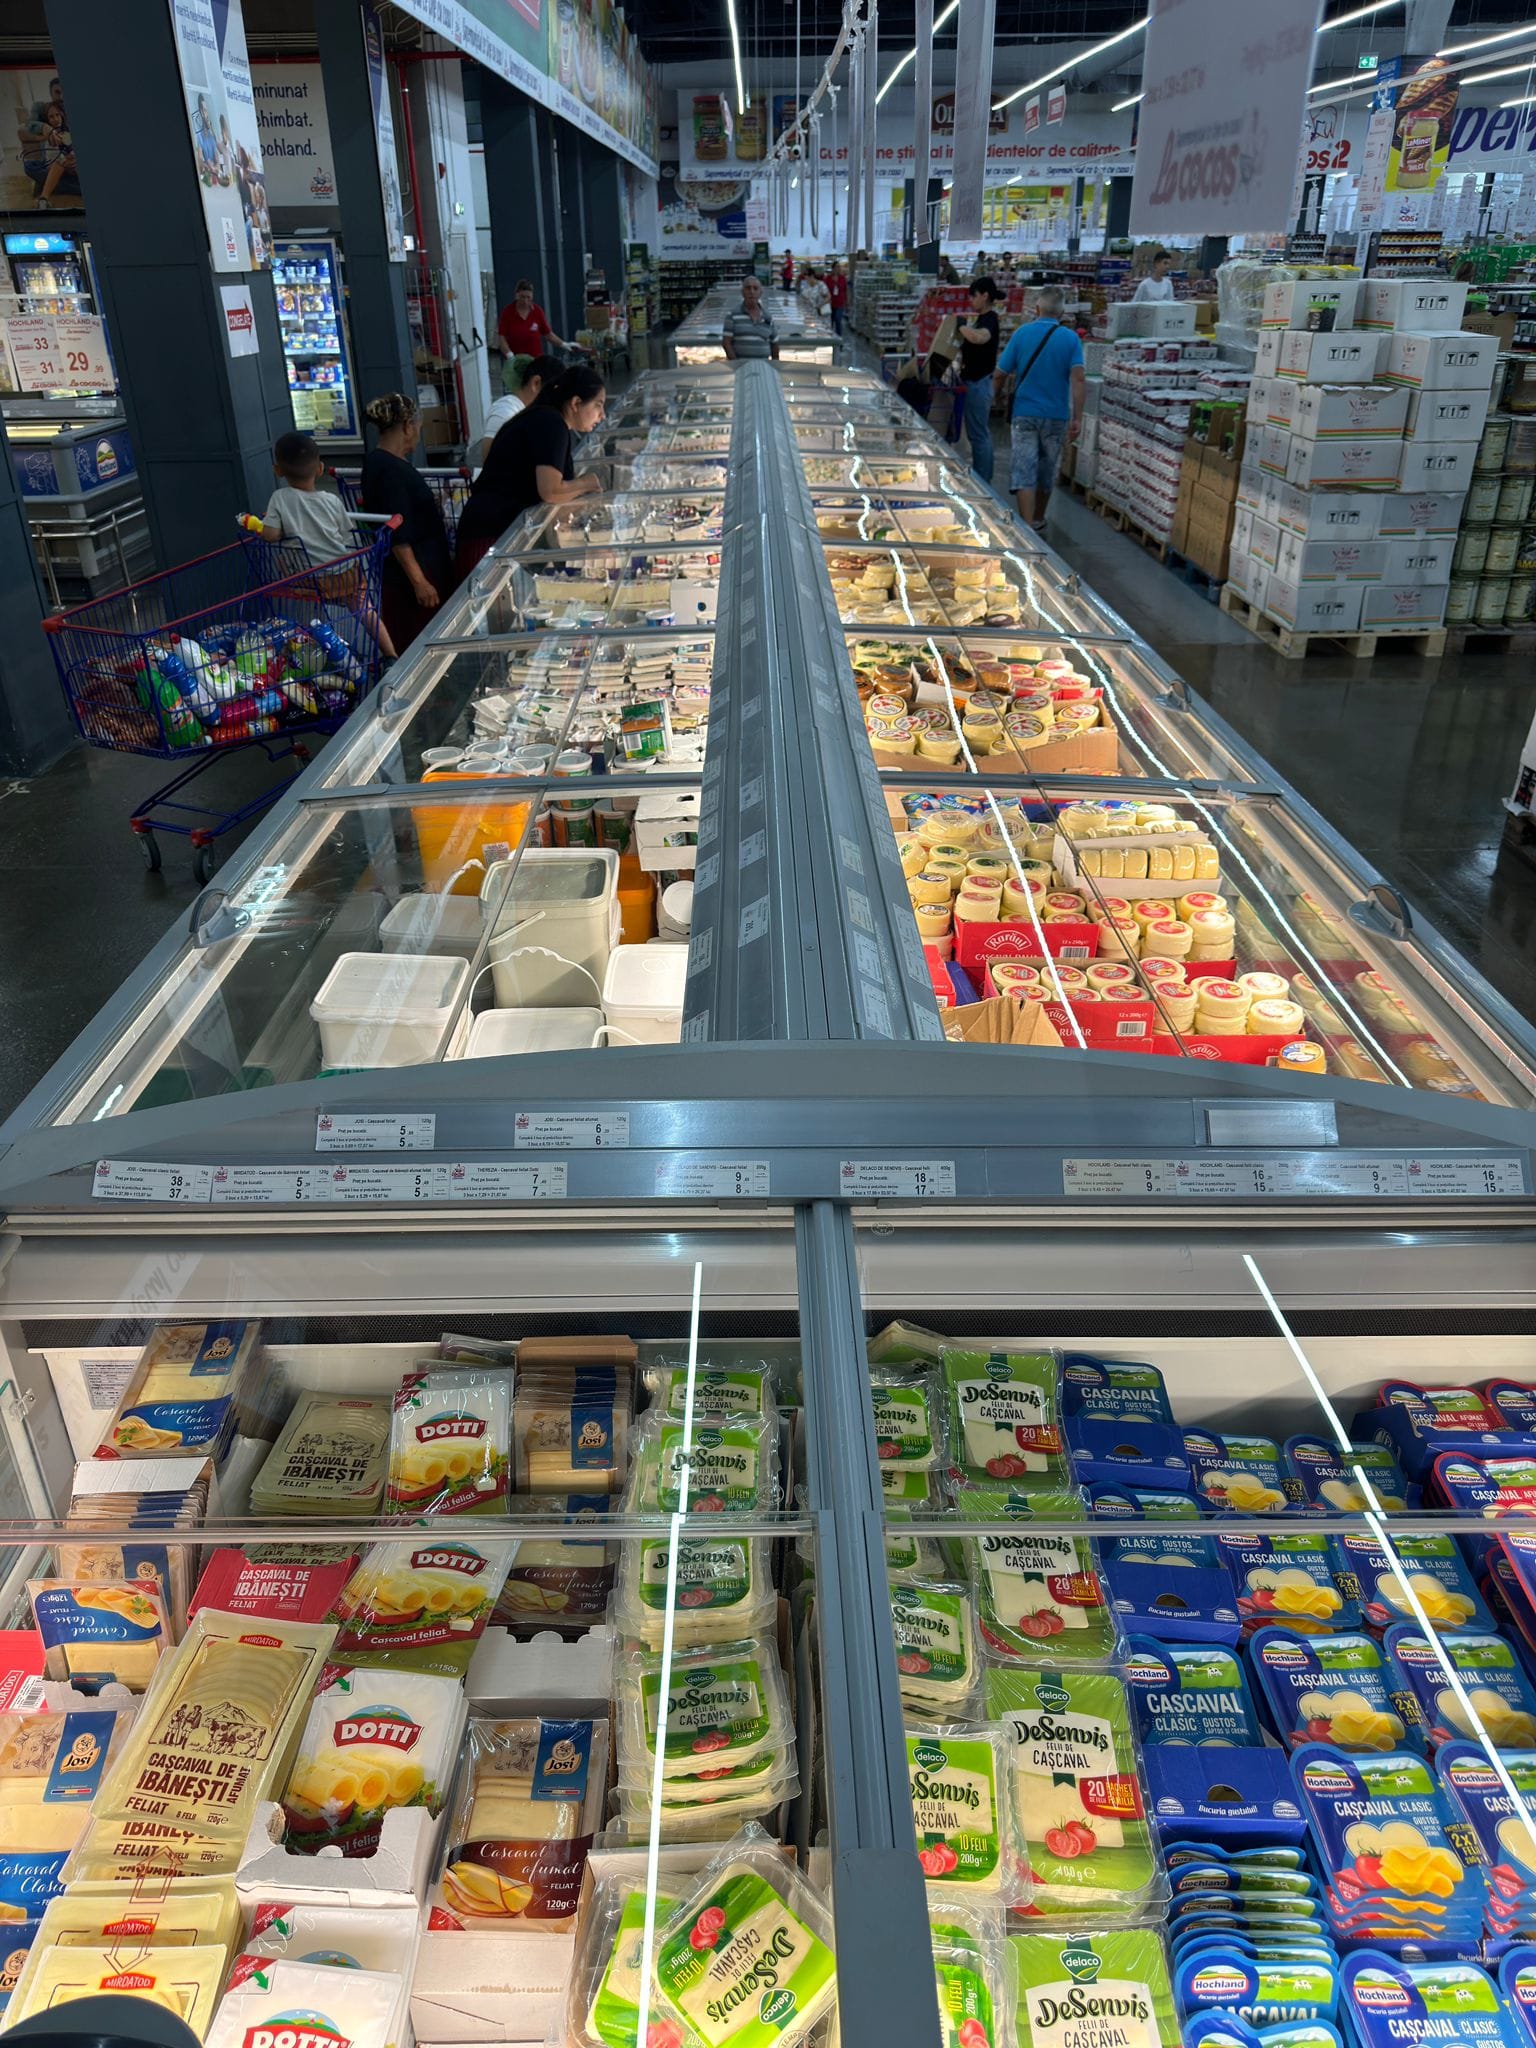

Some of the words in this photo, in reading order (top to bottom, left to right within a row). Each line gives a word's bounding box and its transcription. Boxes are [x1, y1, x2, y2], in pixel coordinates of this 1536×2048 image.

[1048, 144, 1066, 158] de
[1070, 145, 1121, 158] calitate
[1331, 139, 1351, 169] 2
[34, 337, 49, 350] 33
[67, 352, 89, 371] 29
[40, 361, 54, 374] 31
[399, 1126, 406, 1135] 5
[595, 1124, 602, 1133] 6
[399, 1138, 405, 1147] 5
[595, 1136, 601, 1145] 6
[415, 1175, 421, 1185] 5
[532, 1174, 539, 1184] 7
[735, 1172, 742, 1181] 9
[915, 1173, 926, 1183] 18
[1145, 1170, 1152, 1180] 9
[1253, 1170, 1264, 1180] 16
[1372, 1171, 1379, 1181] 9
[1482, 1171, 1494, 1180] 16
[170, 1176, 183, 1186] 38
[296, 1177, 303, 1186] 5
[414, 1187, 420, 1197] 5
[532, 1187, 538, 1196] 7
[735, 1184, 742, 1194] 8
[915, 1185, 927, 1195] 17
[1146, 1182, 1153, 1192] 9
[1253, 1182, 1266, 1192] 15
[1373, 1184, 1380, 1193] 9
[1484, 1183, 1496, 1192] 15
[169, 1188, 181, 1198] 37
[295, 1190, 302, 1199] 5
[207, 1348, 228, 1358] Josi
[988, 1366, 1012, 1375] delaco
[1066, 1372, 1102, 1381] Hochland
[1086, 1400, 1120, 1409] CLASIC
[1124, 1401, 1152, 1409] GUSTOS
[980, 1406, 1026, 1421] CAȘCAVAL
[421, 1422, 479, 1438] DOTTI
[1022, 1427, 1036, 1439] 20
[580, 1435, 602, 1445] Josi
[1296, 1452, 1332, 1461] Hochland
[352, 1460, 369, 1468] DE
[1249, 1463, 1275, 1471] CLASIC
[282, 1463, 366, 1484] IBĂNEȘTI
[1448, 1475, 1485, 1483] Hochland
[278, 1480, 311, 1488] FELIAT
[451, 1491, 476, 1506] feliat
[1120, 1538, 1157, 1549] CLASIC
[1162, 1539, 1193, 1549] GUSTOS
[416, 1553, 480, 1571] DOTTI
[1004, 1554, 1056, 1571] CAȘCAVAL
[1297, 1555, 1325, 1564] CLASIC
[295, 1571, 310, 1581] DE
[1054, 1577, 1070, 1590] 20
[233, 1579, 306, 1601] IBĂNEȘTI
[228, 1600, 258, 1609] FELIAT
[419, 1628, 447, 1639] feliat
[243, 1636, 279, 1647] MIRDATOD
[1265, 1654, 1306, 1663] Hochland
[438, 1664, 458, 1673] 150g
[688, 1675, 715, 1683] delaco
[1290, 1673, 1348, 1689] CAȘCAVAL
[1349, 1674, 1380, 1684] CLASIC
[1485, 1673, 1514, 1683] CLASIC
[1039, 1691, 1068, 1701] delaco
[679, 1709, 733, 1727] CAȘCAVAL
[1155, 1717, 1198, 1731] CLASIC
[1202, 1717, 1236, 1728] GUSTOS
[341, 1721, 413, 1743] DOTTI
[1046, 1742, 1063, 1751] FELII
[1065, 1744, 1073, 1752] DE
[64, 1752, 93, 1767] Josi
[917, 1752, 946, 1763] delaco
[1033, 1749, 1091, 1770] CAȘCAVAL
[546, 1757, 575, 1770] Josi
[216, 1762, 238, 1779] DE
[1307, 1777, 1352, 1787] Hochland
[1454, 1773, 1499, 1783] Hochland
[135, 1768, 230, 1805] IBĂNEȘTI
[227, 1766, 251, 1804] AFUMAT
[1087, 1780, 1105, 1797] 20
[125, 1796, 170, 1815] FELIAT
[919, 1801, 936, 1811] FELII
[937, 1802, 945, 1811] DE
[1199, 1804, 1227, 1815] Bucuria
[1334, 1800, 1398, 1819] CAȘCAVAL
[1400, 1801, 1432, 1812] CLASIC
[206, 1814, 221, 1825] 120g
[1413, 1816, 1440, 1825] GUSTOS
[959, 1834, 969, 1850] 10
[970, 1837, 988, 1852] FELII
[113, 1843, 159, 1857] FELIAT
[960, 1853, 981, 1867] 200g
[522, 1859, 581, 1884] afumat
[1181, 1879, 1227, 1888] Hochland
[546, 1899, 567, 1910] 120g
[107, 1923, 150, 1935] MIRDATOD
[708, 1928, 761, 1982] CAȘCAVAL
[690, 1958, 704, 1974] 10
[742, 1953, 757, 1972] FELII
[1065, 1956, 1100, 1967] delaco
[672, 1970, 691, 1990] FELII
[734, 1969, 743, 1981] DE
[105, 1976, 151, 1988] MIRDATOD
[1195, 1980, 1245, 1989] Hochland
[1358, 1989, 1406, 2001] Hochland
[762, 1991, 790, 2022] delaco
[1078, 2019, 1097, 2030] FELII
[1099, 2019, 1109, 2029] DE
[1388, 2019, 1460, 2043] CAȘCAVAL
[1461, 2020, 1498, 2035] CLASIC
[251, 2030, 342, 2048] DOTTI
